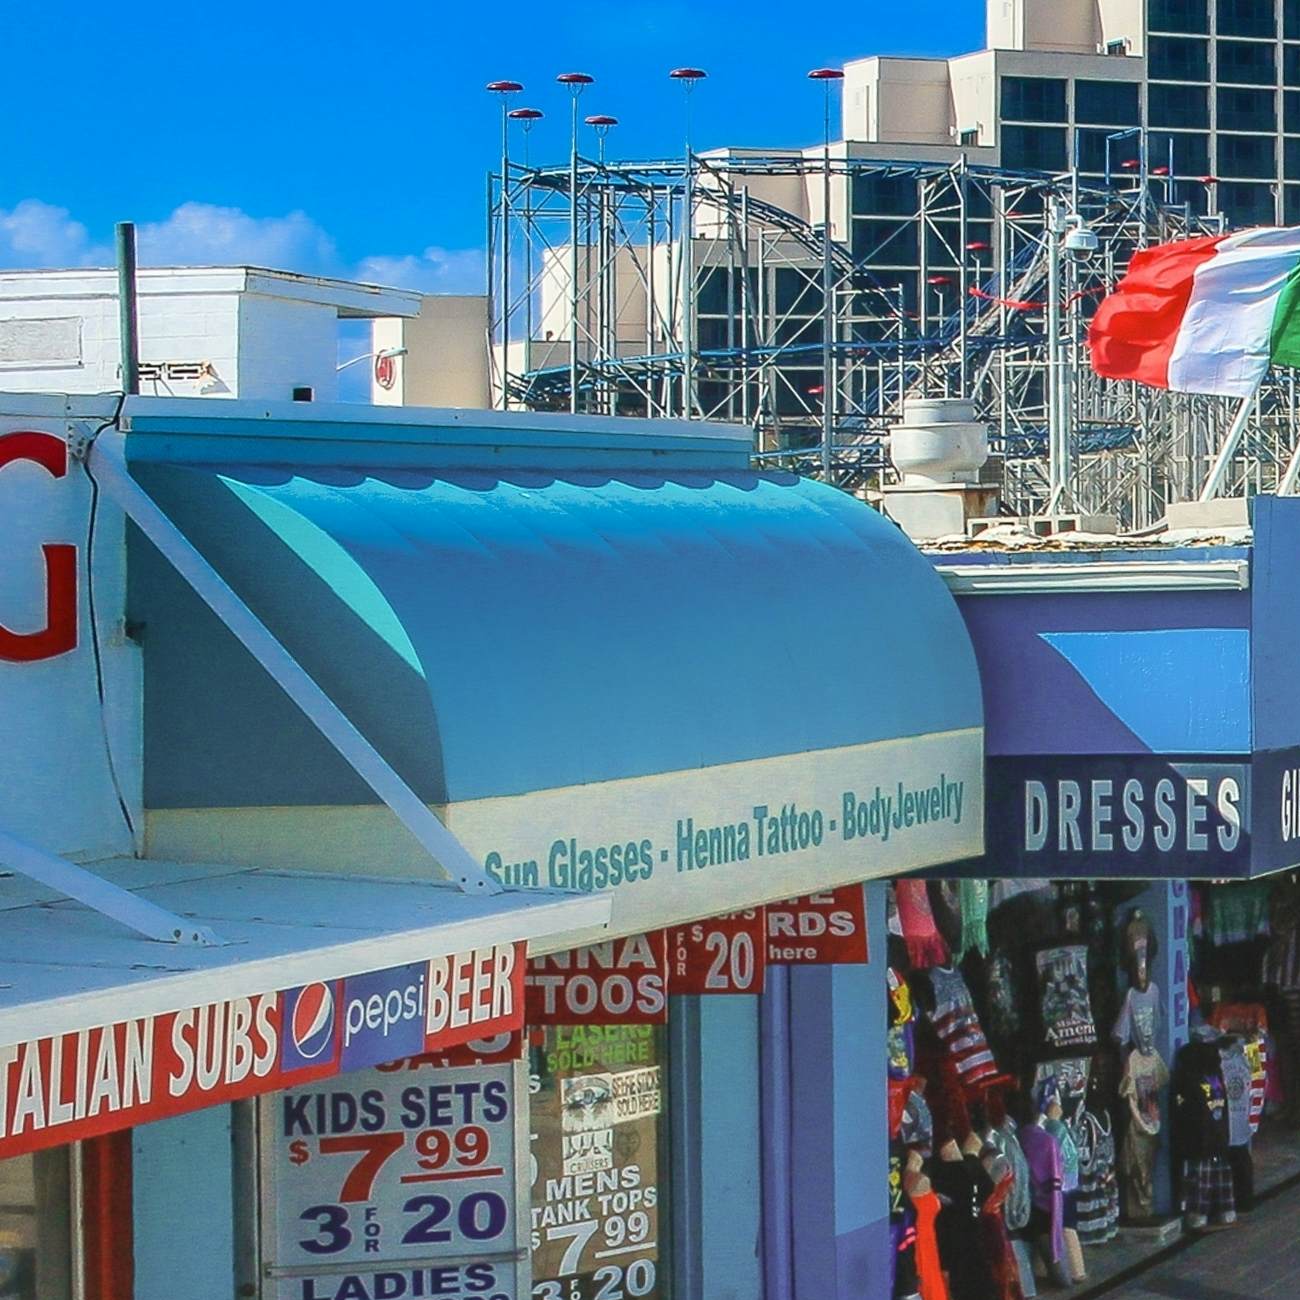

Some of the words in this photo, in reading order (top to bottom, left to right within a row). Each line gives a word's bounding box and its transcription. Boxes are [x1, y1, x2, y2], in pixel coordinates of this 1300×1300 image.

[1024, 777, 1240, 852] DRESSES
[484, 850, 539, 887] Sun
[549, 837, 653, 892] Glasses
[676, 818, 750, 872] Henna
[753, 805, 823, 856] Tattoo
[768, 911, 855, 937] RDS
[676, 932, 687, 976] FOR
[769, 944, 817, 960] here
[344, 976, 425, 1047] pepsi
[426, 942, 515, 1036] BEER
[169, 991, 279, 1098] SUBS
[547, 1050, 594, 1072] SOLD
[603, 1041, 648, 1064] HERE
[284, 1089, 386, 1136] KIDS
[401, 1081, 507, 1129] SETS
[617, 1099, 637, 1118] SOLD
[531, 1199, 591, 1229] TANK
[598, 1186, 657, 1216] TOPS
[546, 1165, 641, 1201] MENS
[300, 1206, 352, 1254] 3
[364, 1207, 380, 1253] FOR
[401, 1192, 507, 1244] 20
